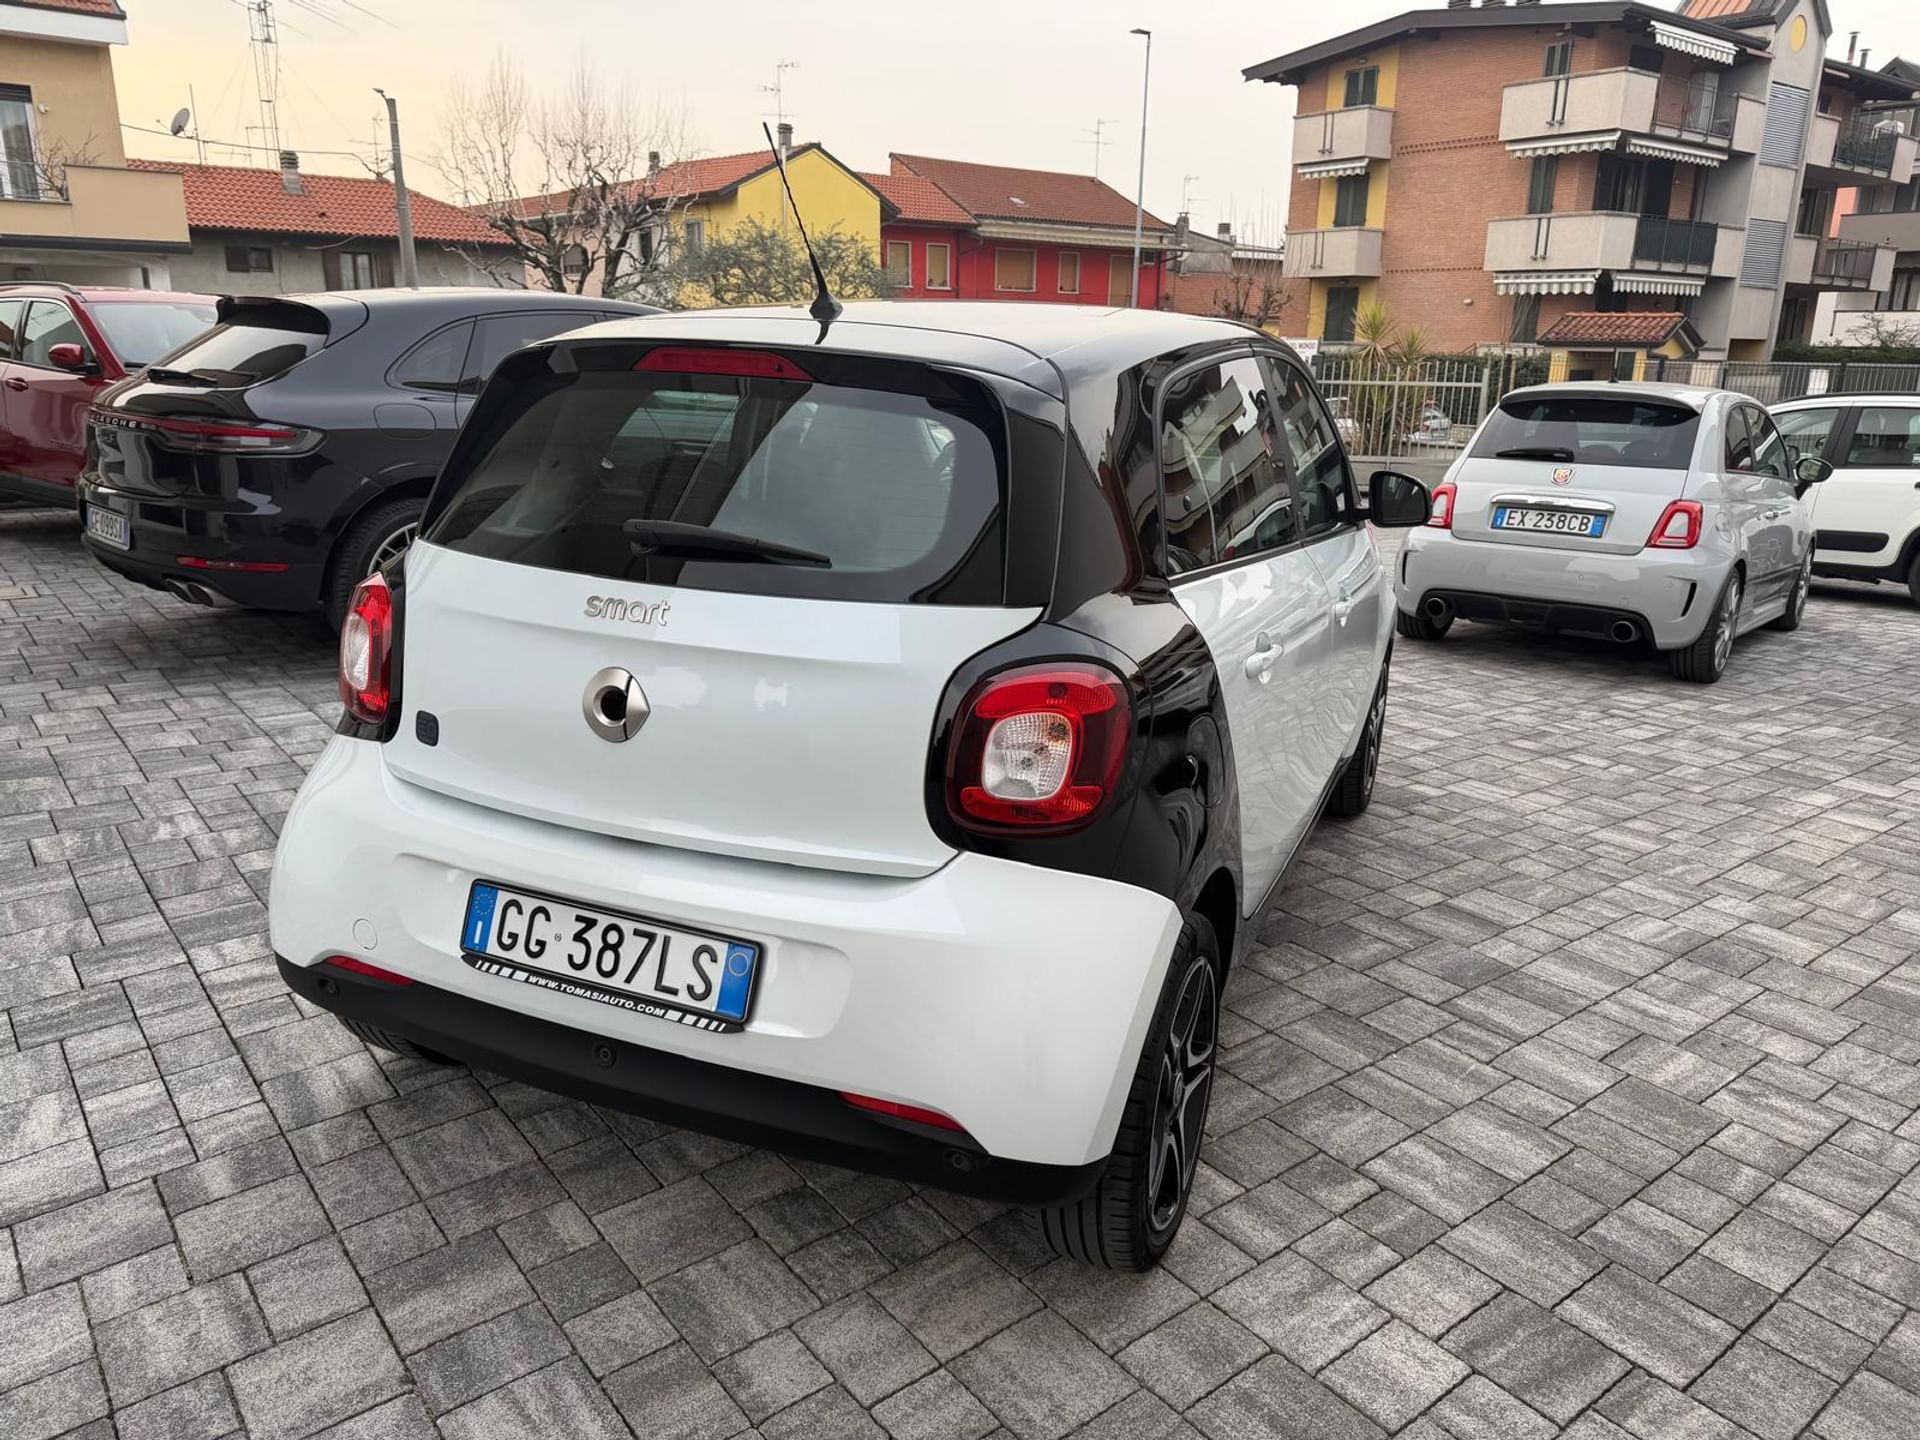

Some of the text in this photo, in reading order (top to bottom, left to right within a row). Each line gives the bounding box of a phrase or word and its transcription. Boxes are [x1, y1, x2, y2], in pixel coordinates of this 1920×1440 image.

[1506, 510, 1529, 527] EX
[1533, 512, 1591, 532] 238CB
[584, 595, 671, 627] smart
[473, 899, 718, 1002] I GG 387LS
[528, 974, 665, 1017] WWW.TOMASIAUTO.COM
